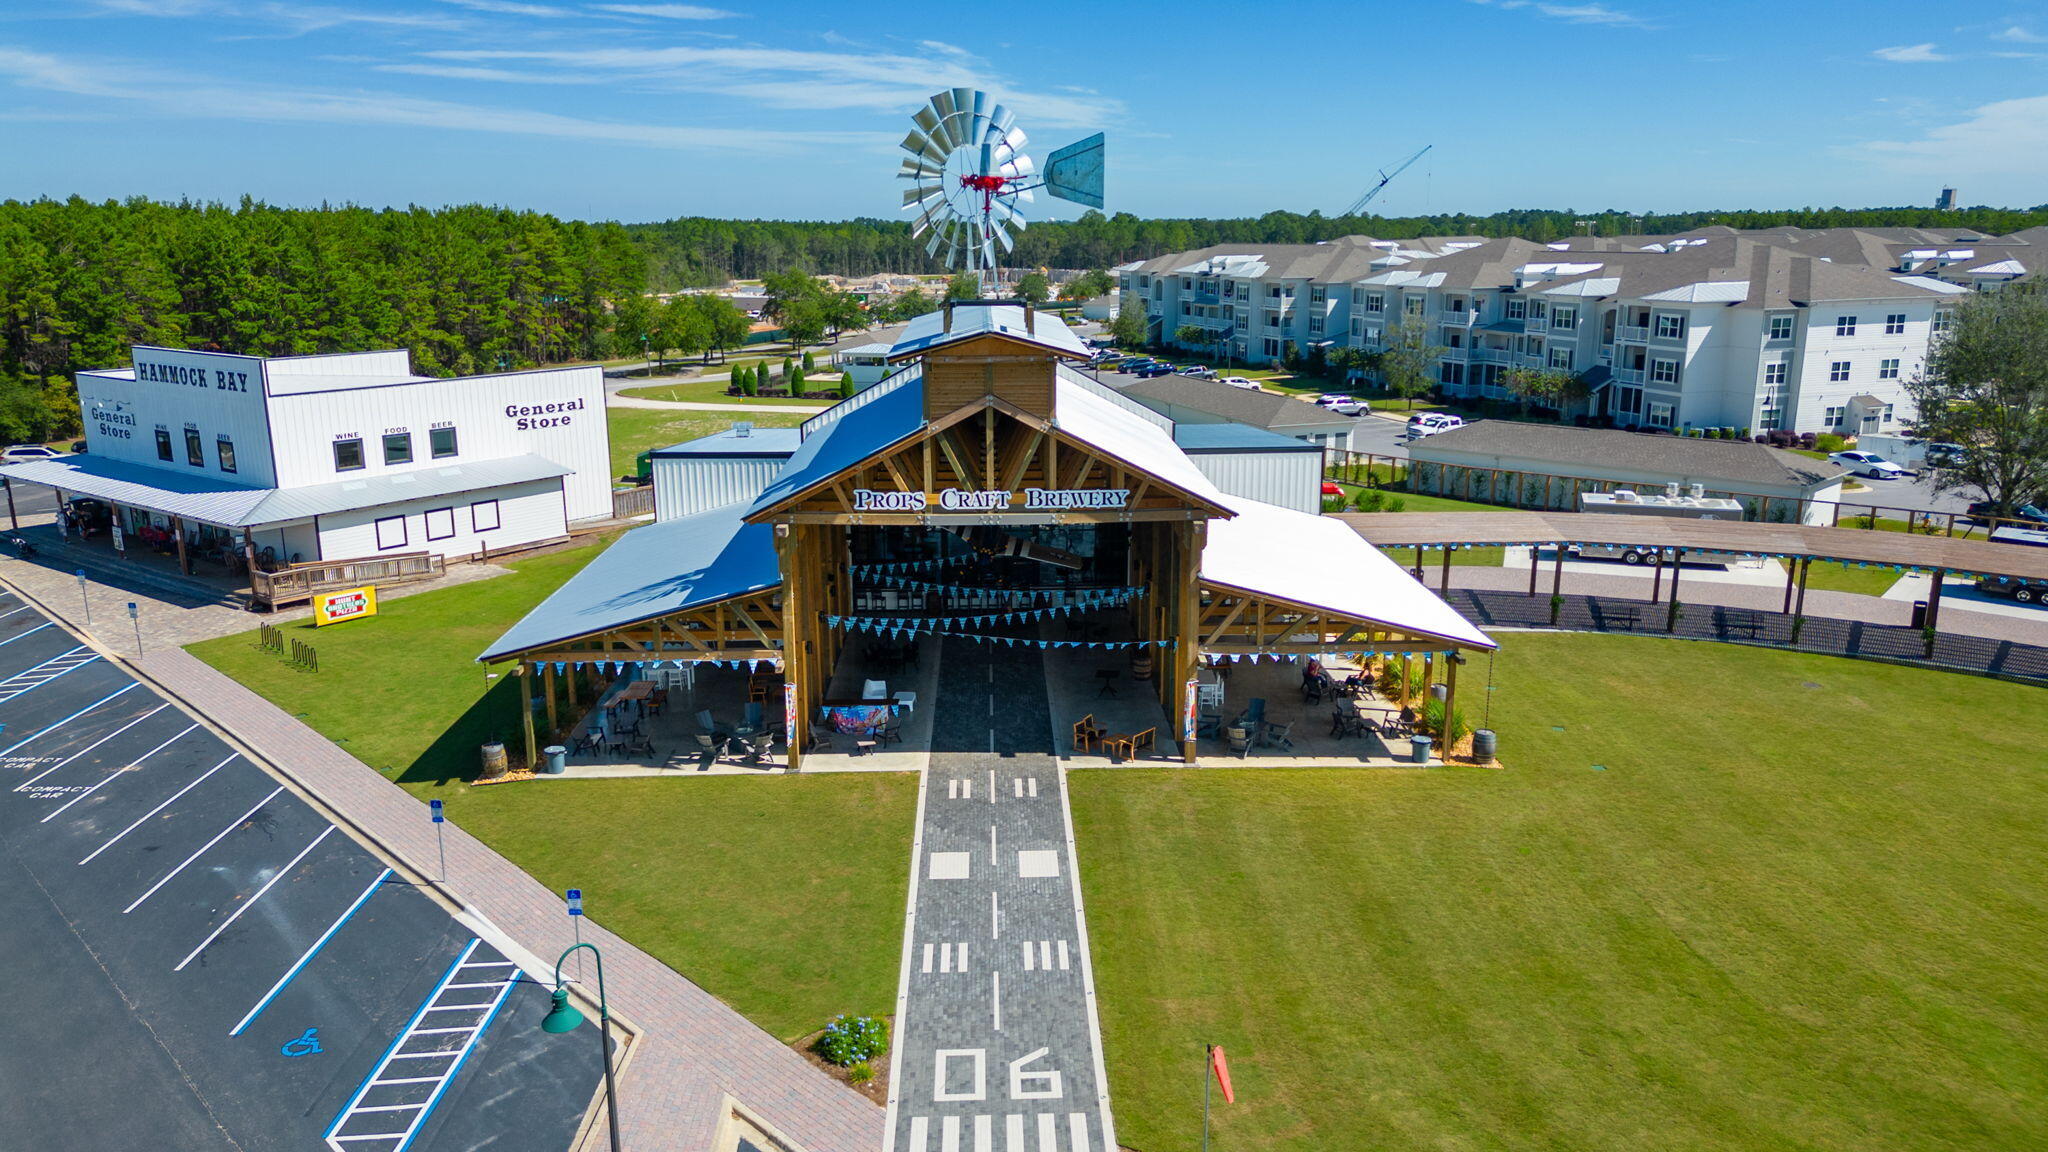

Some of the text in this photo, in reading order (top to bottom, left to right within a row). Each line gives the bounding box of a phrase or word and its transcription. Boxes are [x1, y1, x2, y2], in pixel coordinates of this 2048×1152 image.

[138, 362, 248, 393] HAMMOCK BAY
[505, 397, 585, 418] General
[91, 407, 137, 426] General
[431, 420, 454, 429] BEER
[516, 415, 571, 431] Store
[99, 422, 131, 439] Store
[335, 431, 360, 440] WINE
[384, 426, 409, 434] FOOD
[855, 488, 1130, 510] PROPS CRAFT BREWERY
